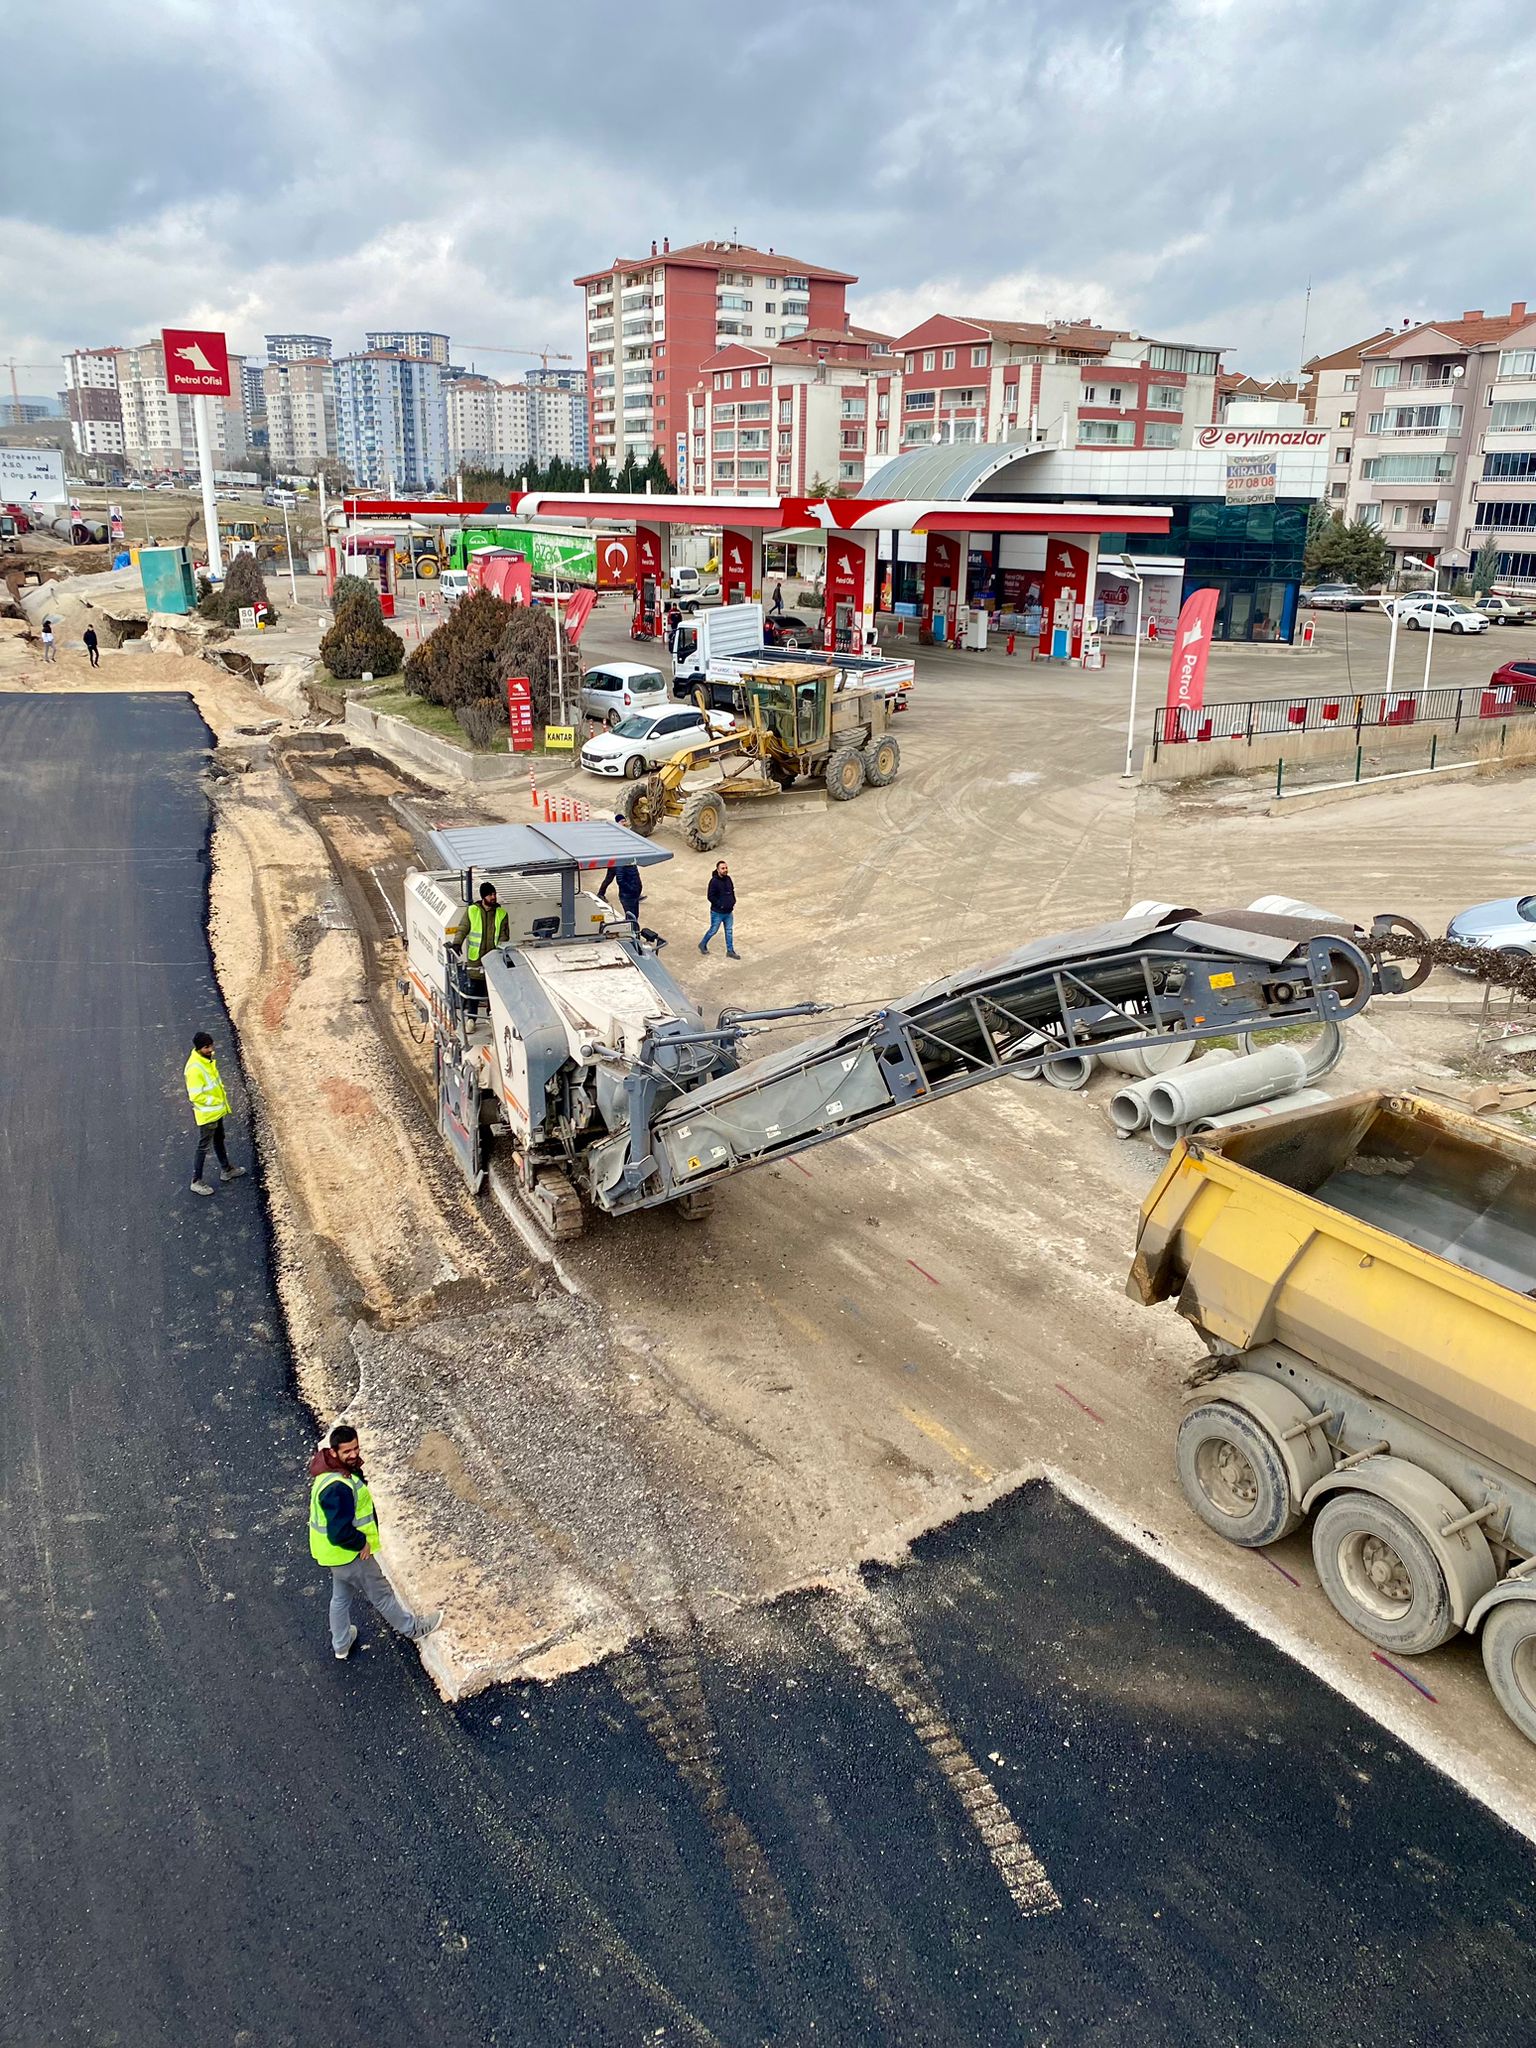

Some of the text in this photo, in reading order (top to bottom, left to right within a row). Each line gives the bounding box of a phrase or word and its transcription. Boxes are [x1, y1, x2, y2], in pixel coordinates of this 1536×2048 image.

[174, 374, 223, 386] Petrol Ofisi
[1225, 430, 1326, 447] eryılmazlar
[1227, 476, 1274, 489] 217 08 08
[1178, 654, 1198, 700] Petrol
[547, 733, 573, 741] KANTAR
